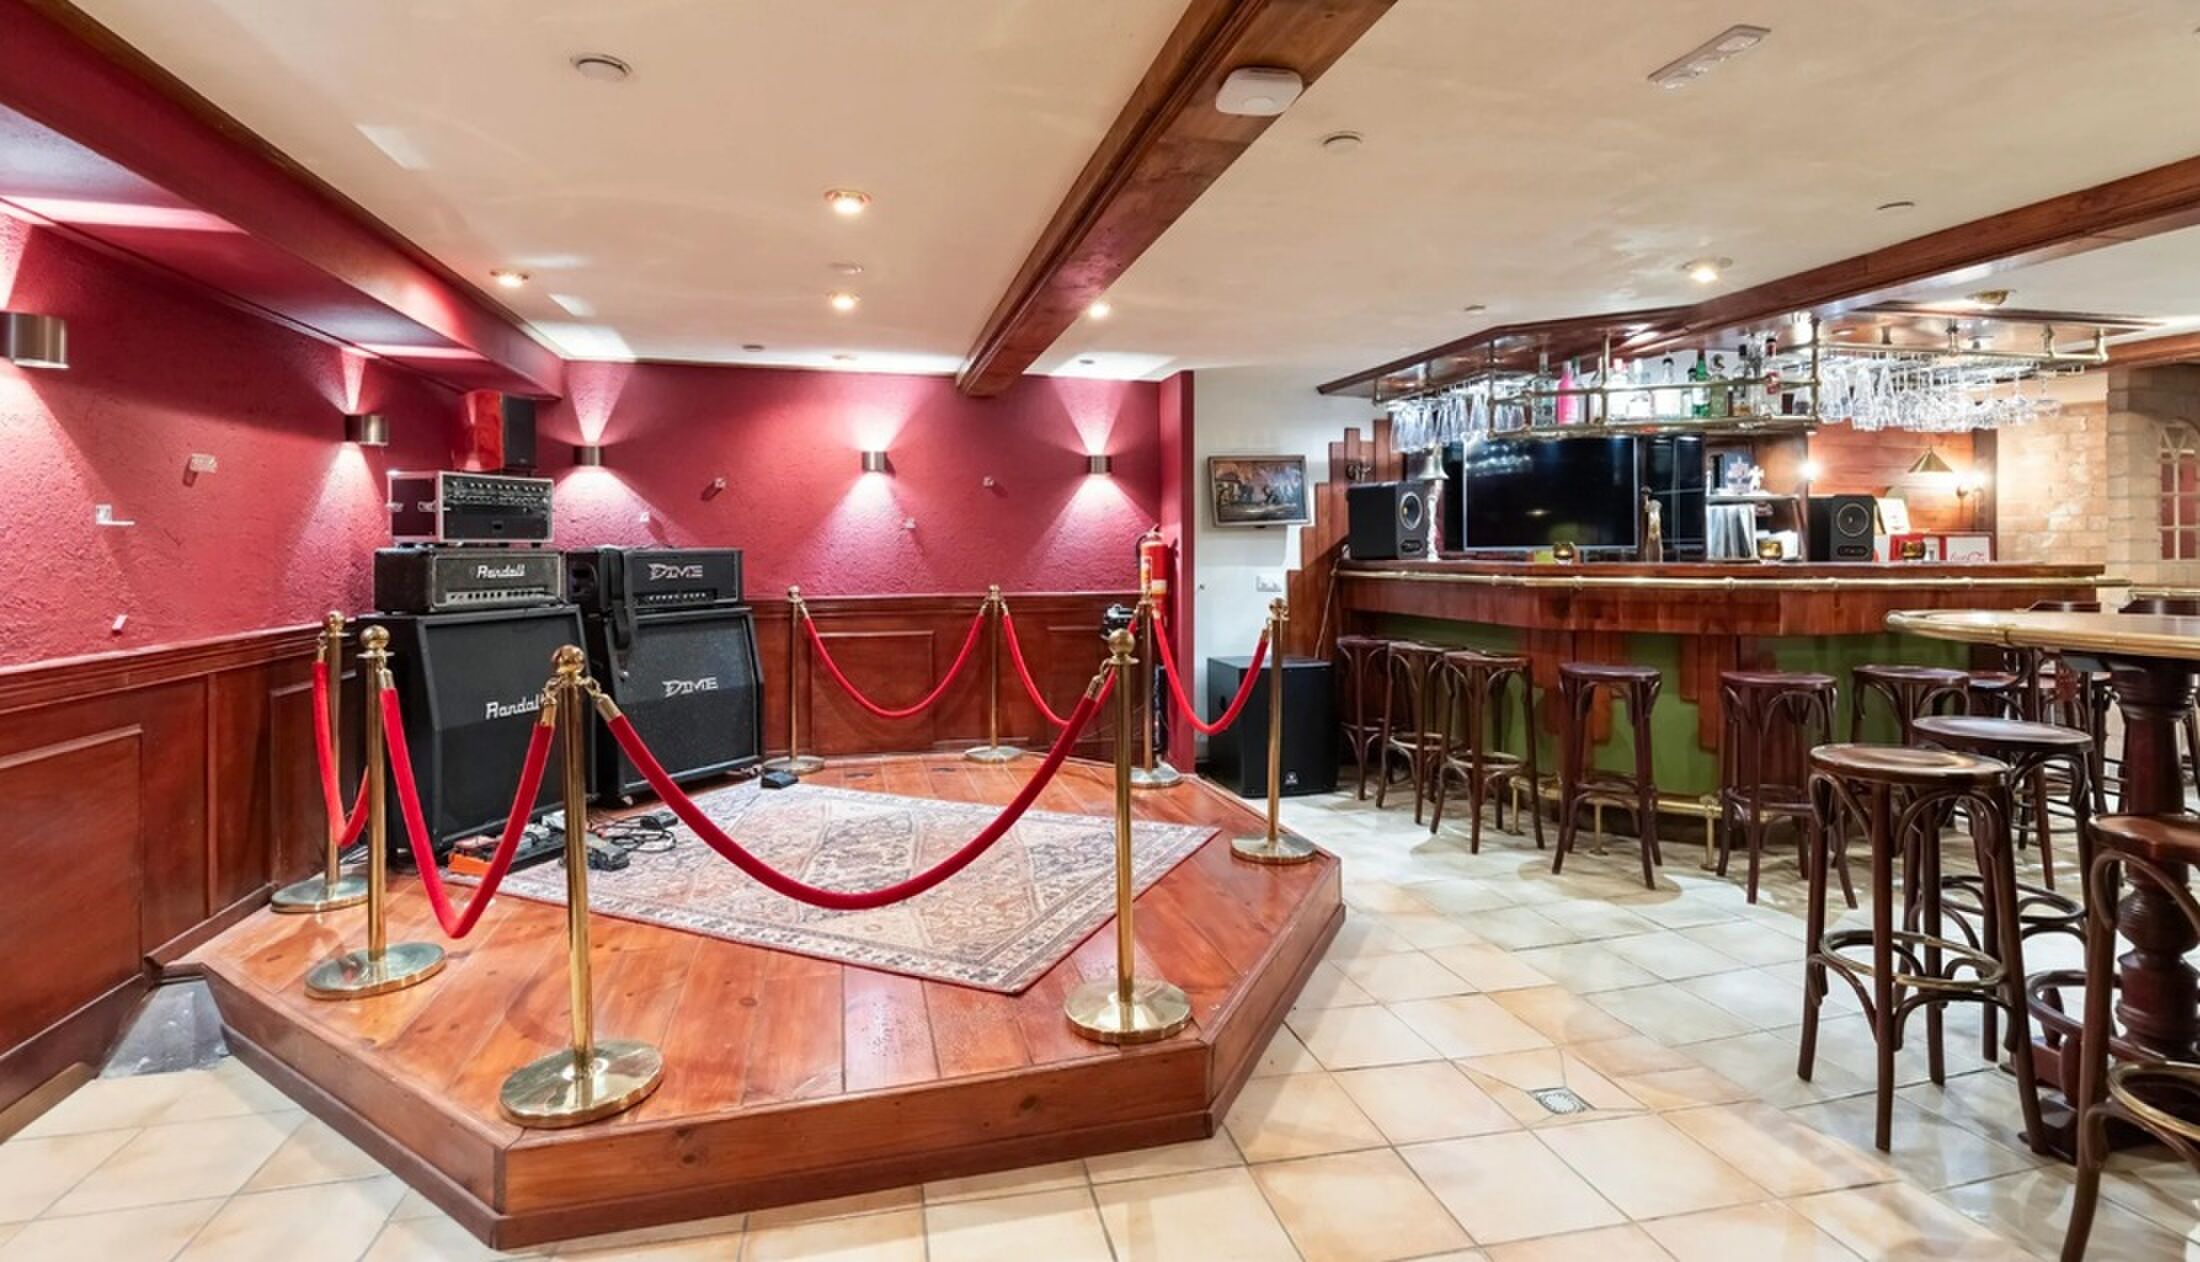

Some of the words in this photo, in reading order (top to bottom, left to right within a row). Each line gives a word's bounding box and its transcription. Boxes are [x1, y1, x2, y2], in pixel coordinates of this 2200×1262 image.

[476, 564, 525, 578] Randall
[648, 563, 703, 580] DIME
[662, 677, 718, 697] DIME
